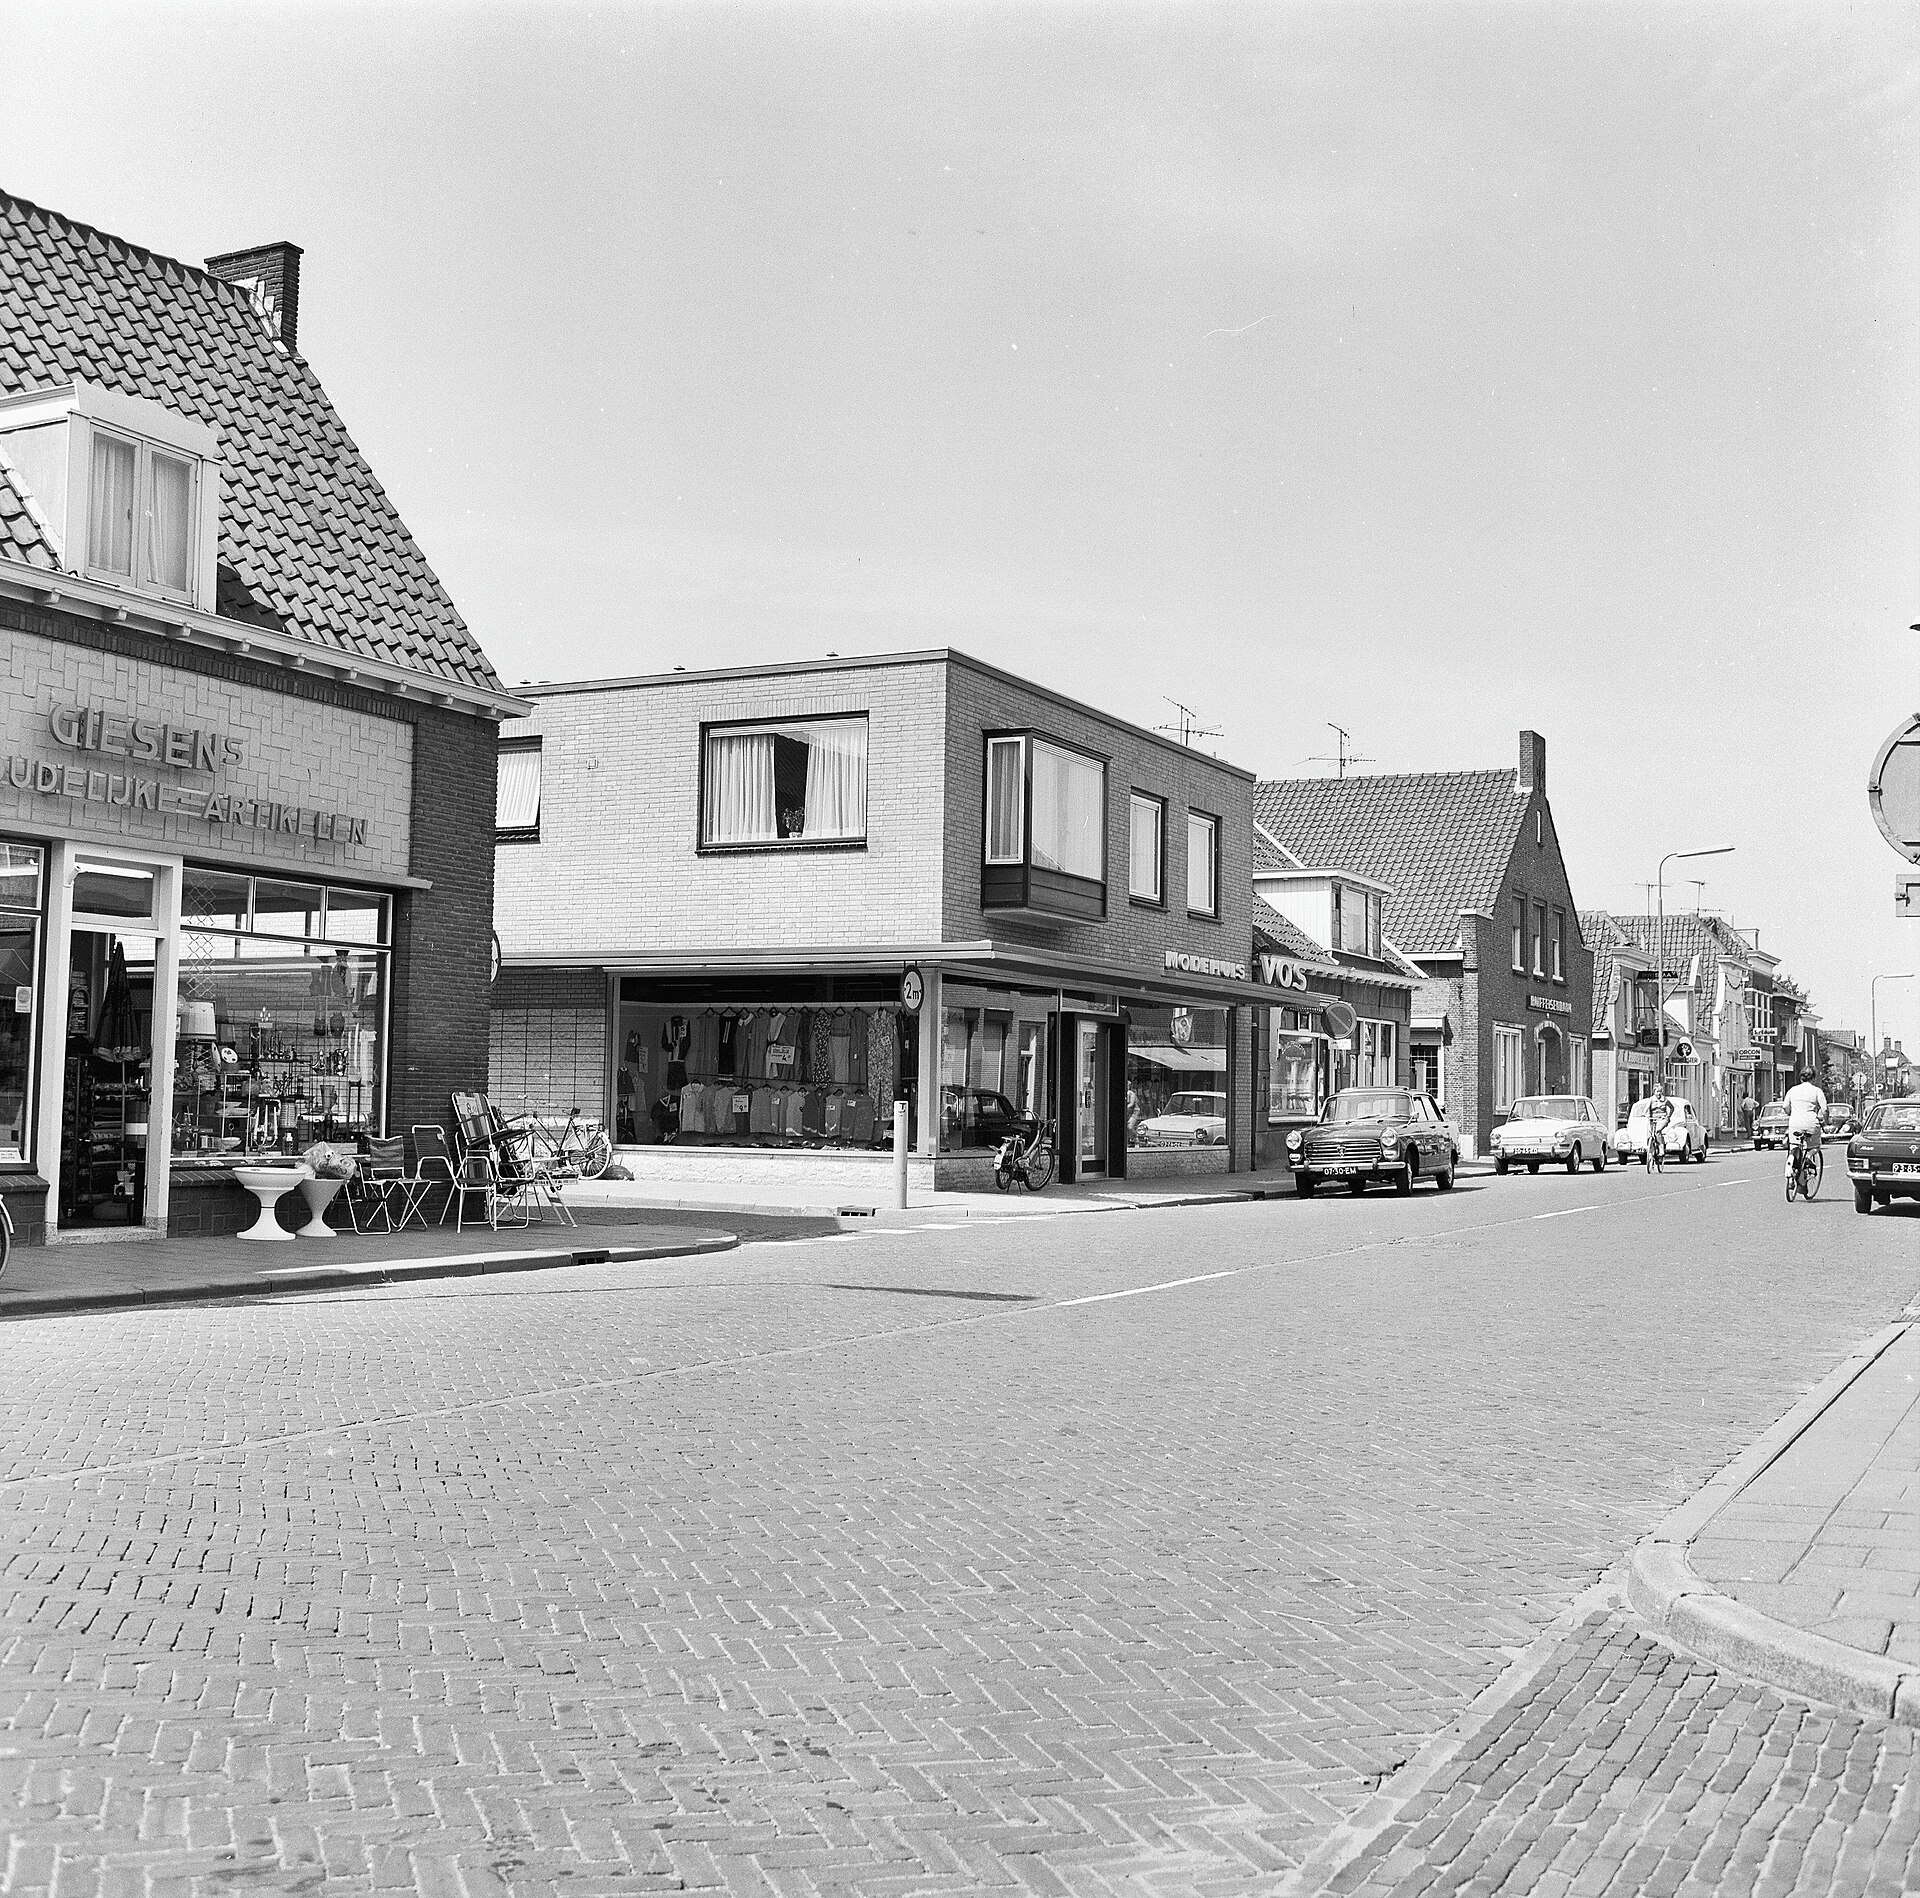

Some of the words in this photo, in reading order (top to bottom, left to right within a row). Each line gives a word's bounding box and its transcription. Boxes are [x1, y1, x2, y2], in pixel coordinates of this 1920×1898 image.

[51, 703, 244, 773] GIESENS
[203, 792, 369, 846] ARTIKELEN
[1164, 951, 1246, 981] MODEHUIS
[1259, 953, 1308, 991] VOS
[1323, 1167, 1357, 1176] 07-30-EM
[1893, 1164, 1920, 1173] 93-85-
